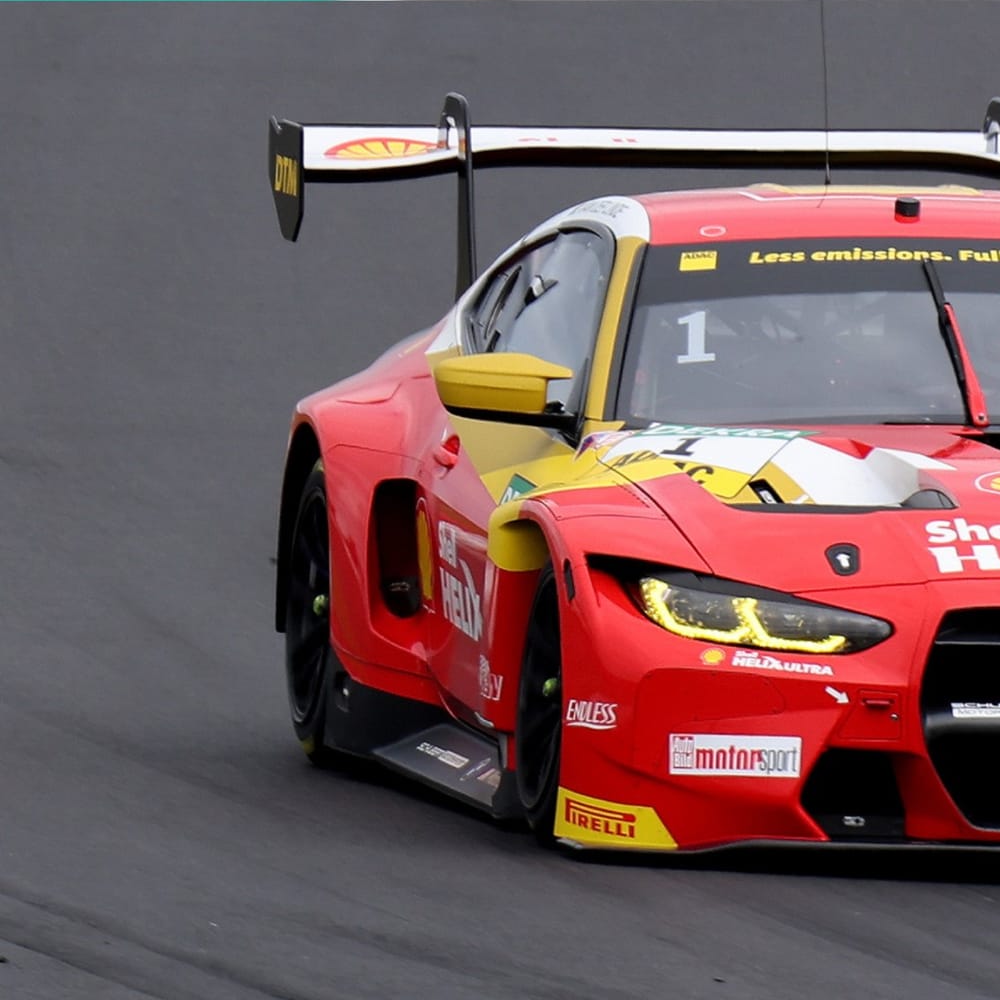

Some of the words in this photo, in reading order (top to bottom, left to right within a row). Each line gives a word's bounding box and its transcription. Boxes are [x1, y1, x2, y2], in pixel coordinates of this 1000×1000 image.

[749, 251, 805, 264] Less
[811, 246, 953, 262] emissions.
[676, 311, 716, 364] 1
[660, 437, 706, 457] 1
[439, 558, 483, 643] HELIX
[731, 655, 784, 671] HELIX
[783, 661, 834, 676] ULTRA
[566, 700, 618, 724] ENDLESS
[564, 797, 637, 839] PIRELLI
